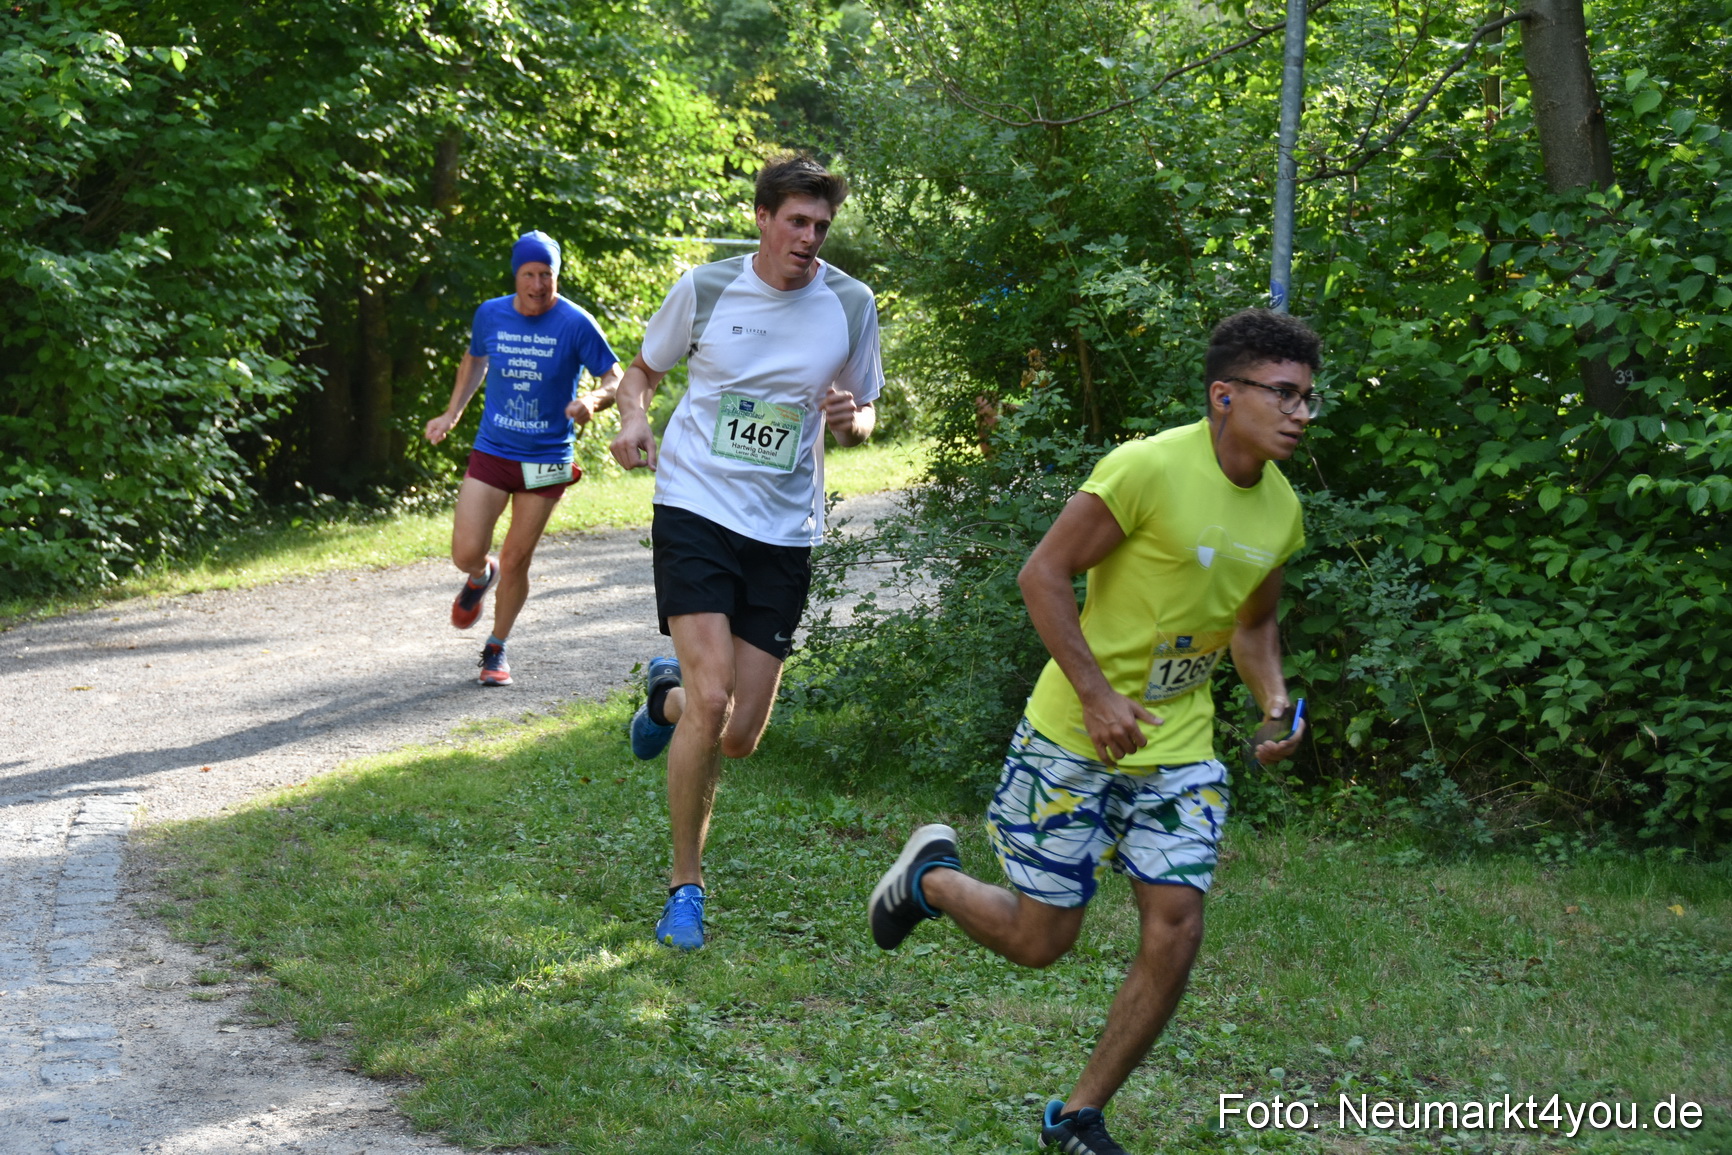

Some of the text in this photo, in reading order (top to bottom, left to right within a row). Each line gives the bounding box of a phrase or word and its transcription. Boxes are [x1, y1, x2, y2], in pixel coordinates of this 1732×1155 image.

[497, 331, 557, 345] Wenn es beim
[497, 343, 554, 357] Hausverkauf
[508, 358, 537, 370] richtig
[501, 368, 542, 381] LAUFEN
[727, 418, 790, 450] 1467
[732, 442, 777, 457] Hartwig Daniel
